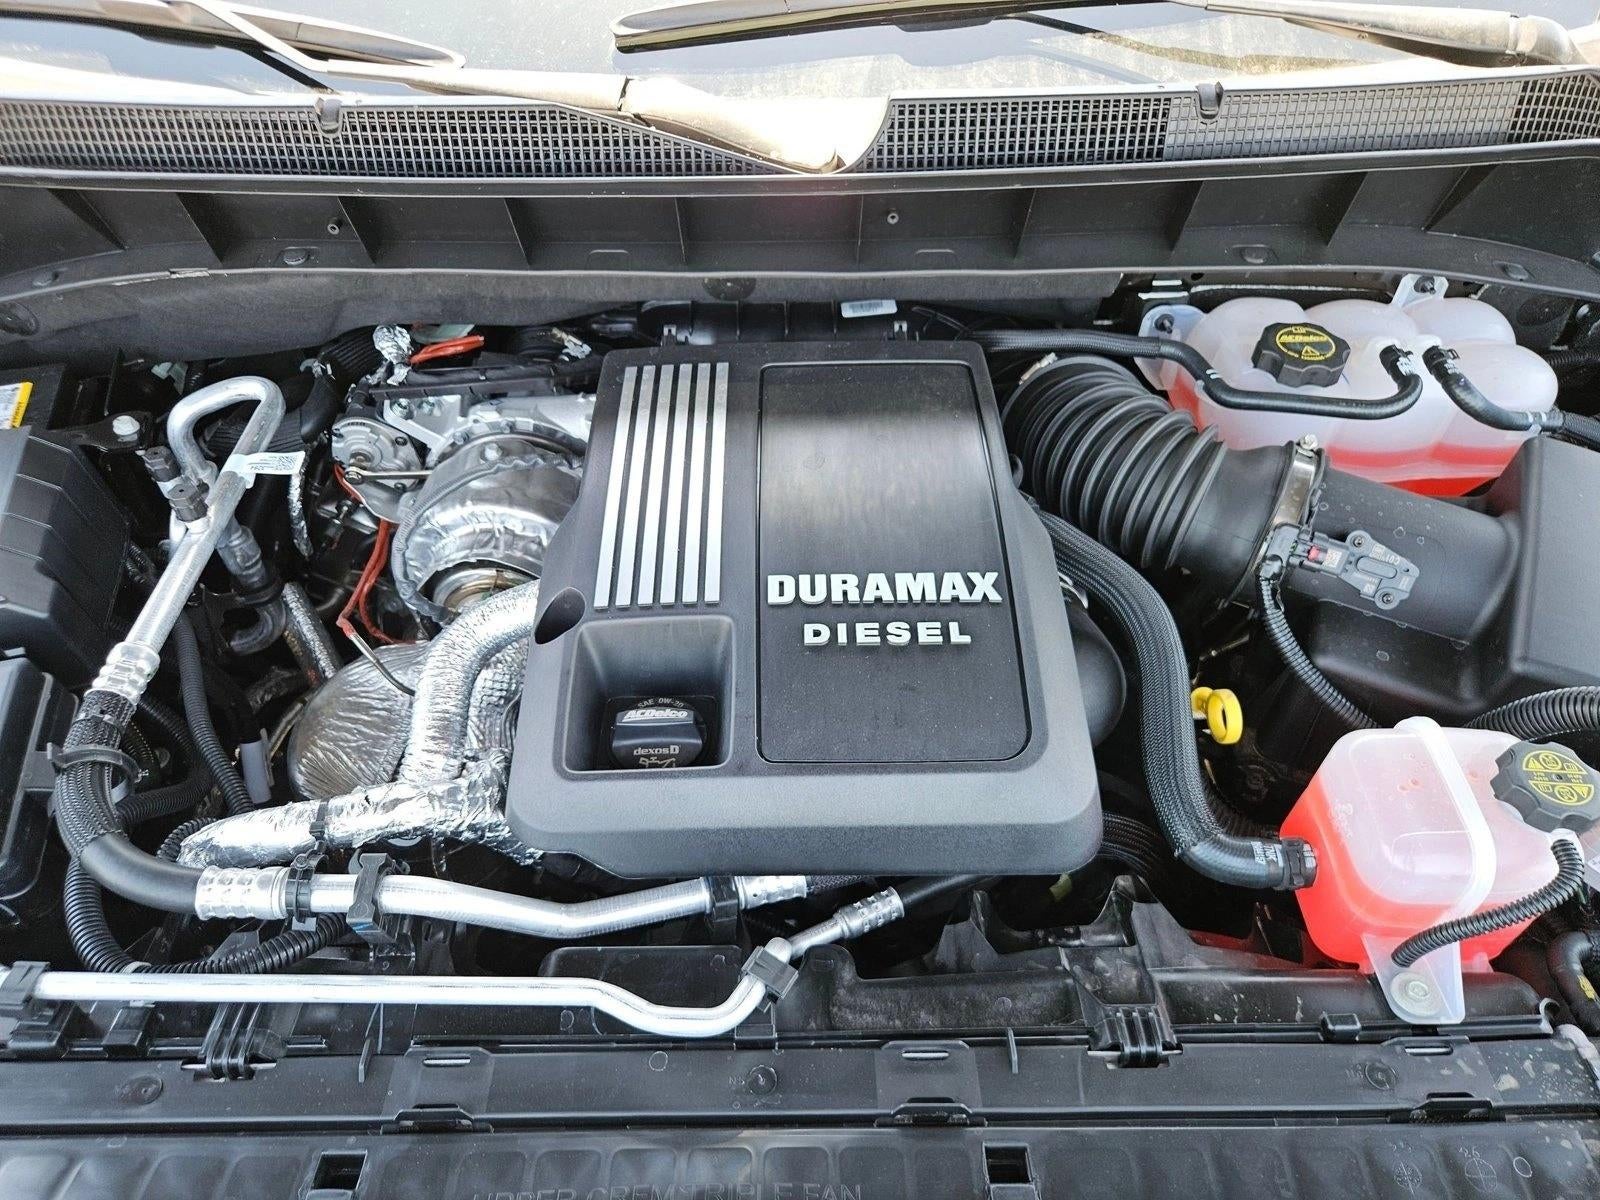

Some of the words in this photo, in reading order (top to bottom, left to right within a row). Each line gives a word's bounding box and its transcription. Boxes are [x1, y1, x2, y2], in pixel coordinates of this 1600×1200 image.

[767, 572, 1003, 606] DURAMAX
[803, 621, 972, 647] DIESEL
[637, 698, 655, 708] SAE
[658, 697, 685, 708] 0W-20
[622, 708, 689, 722] ACDelco
